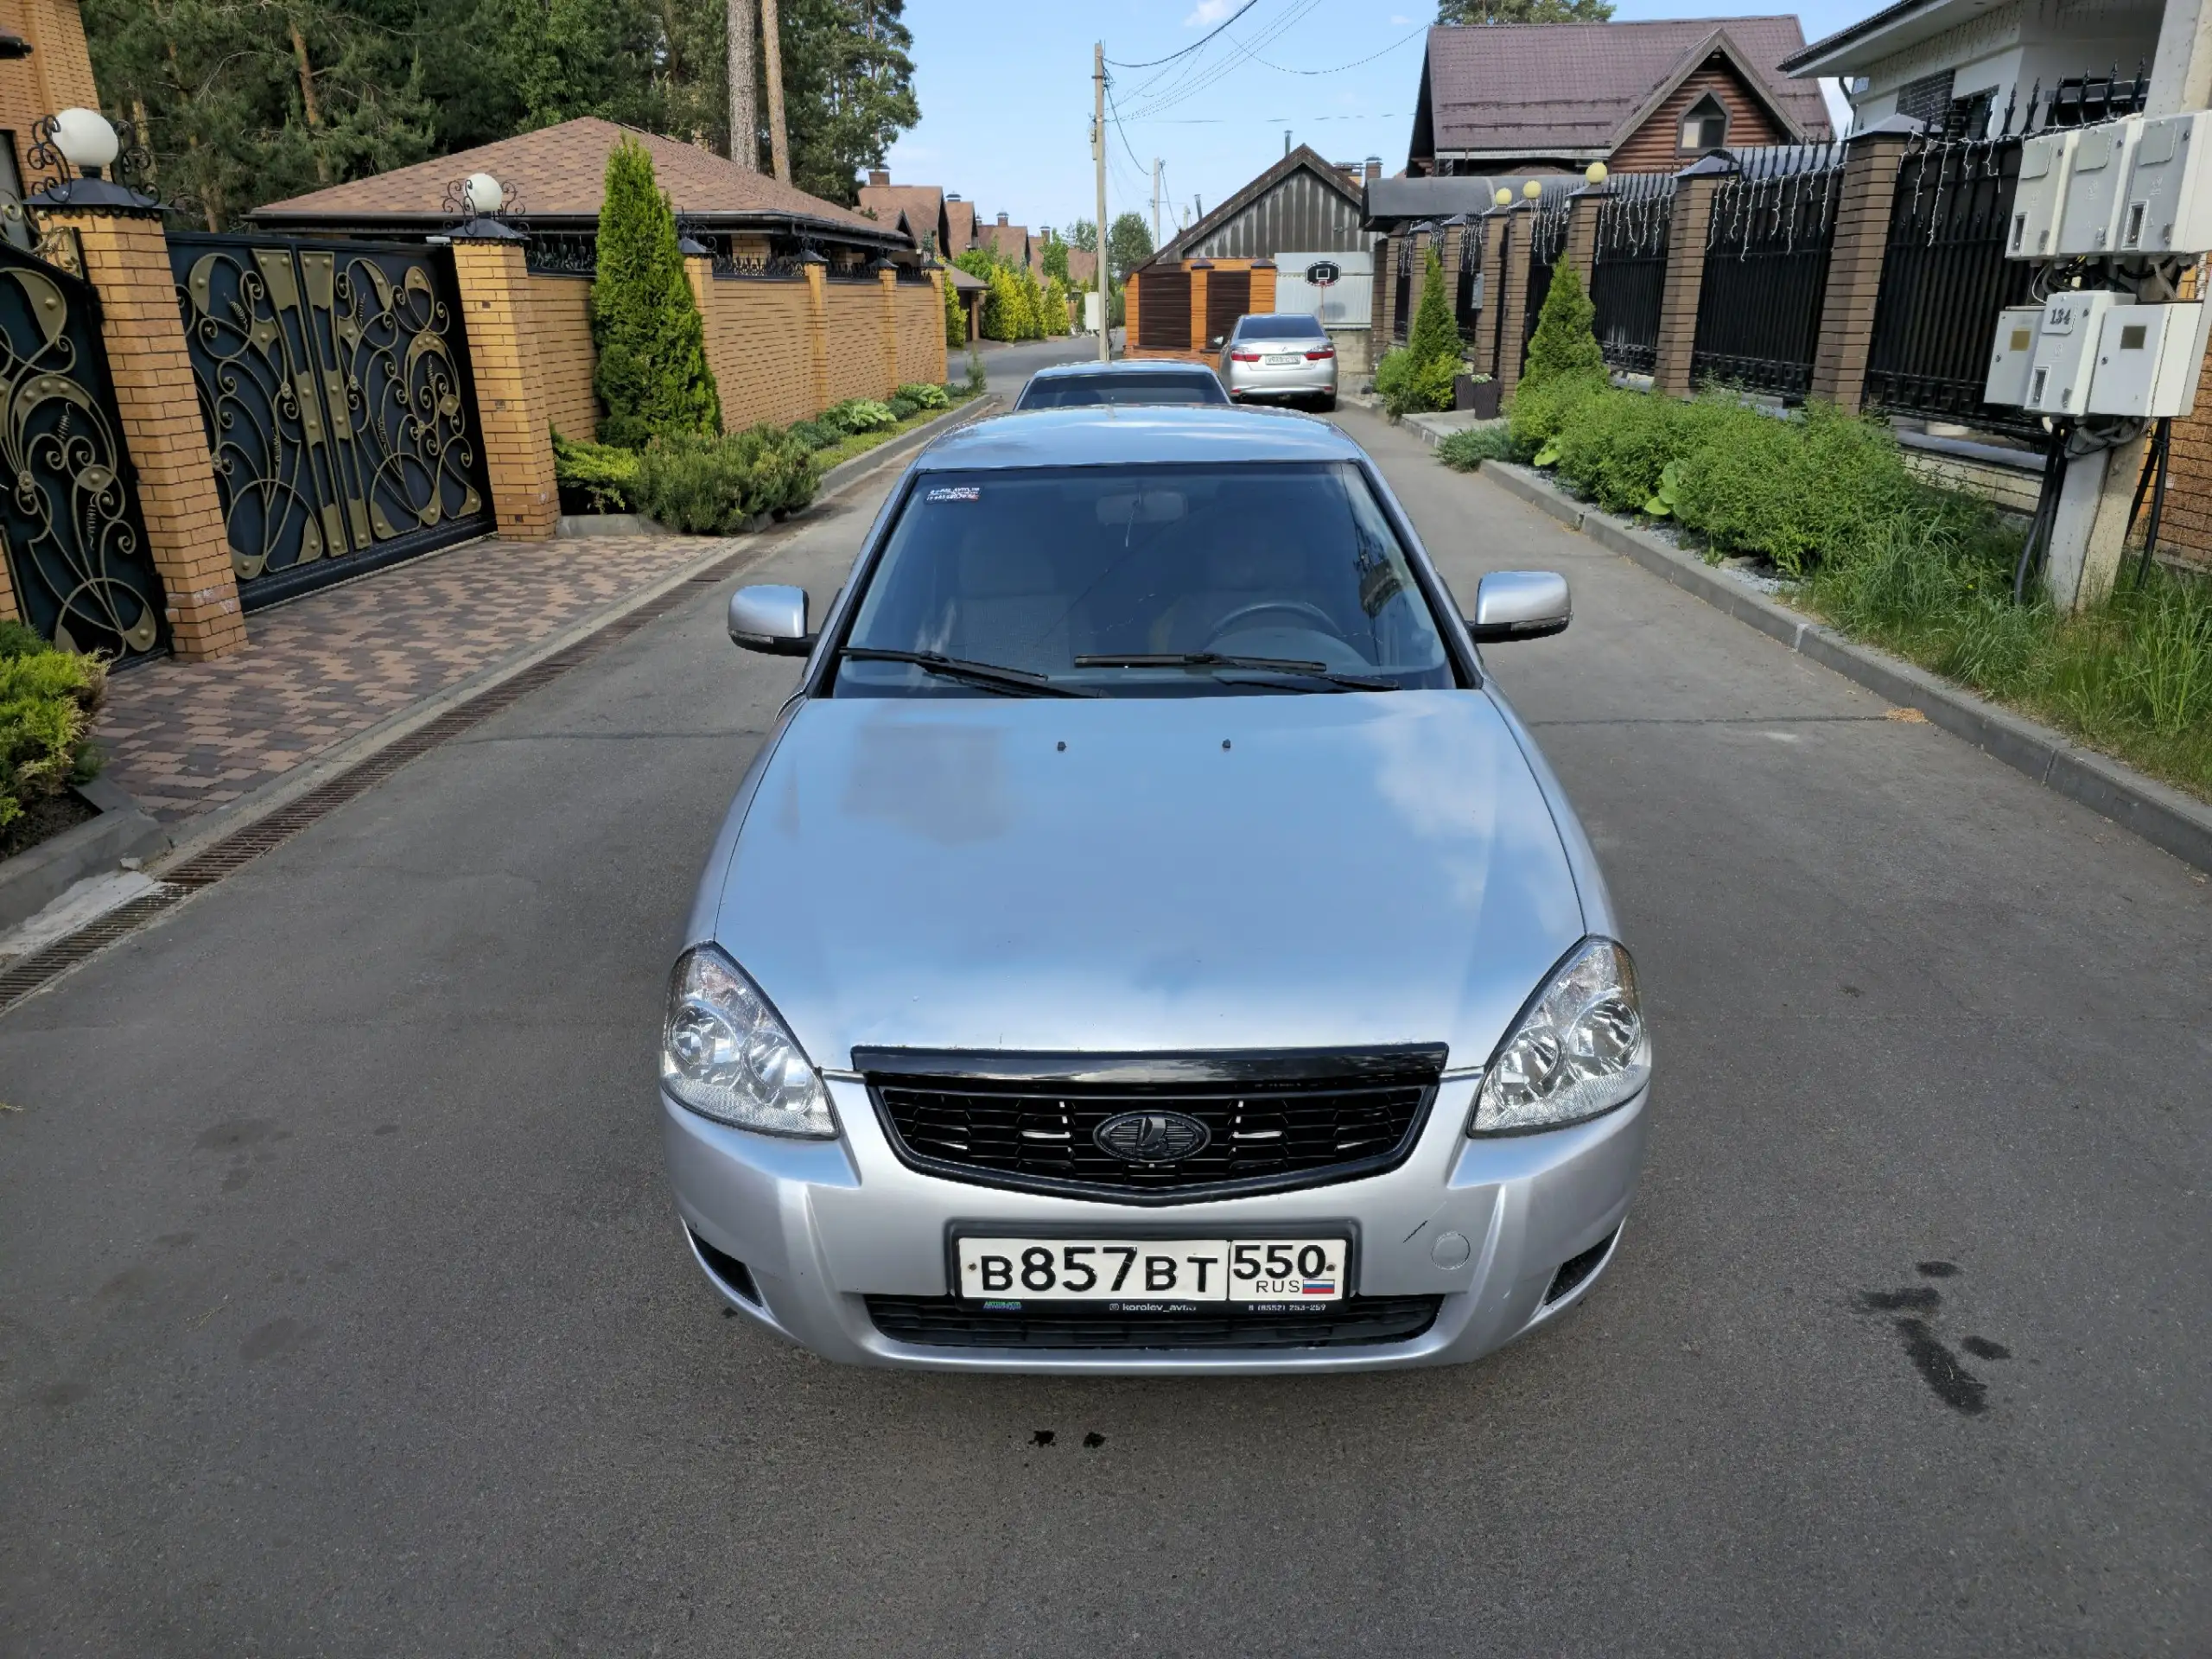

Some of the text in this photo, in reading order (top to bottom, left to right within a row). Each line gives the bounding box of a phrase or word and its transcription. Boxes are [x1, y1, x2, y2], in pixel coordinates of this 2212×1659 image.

[2050, 308, 2071, 325] 134
[1233, 1244, 1326, 1281] 550
[1255, 1280, 1300, 1294] RUS
